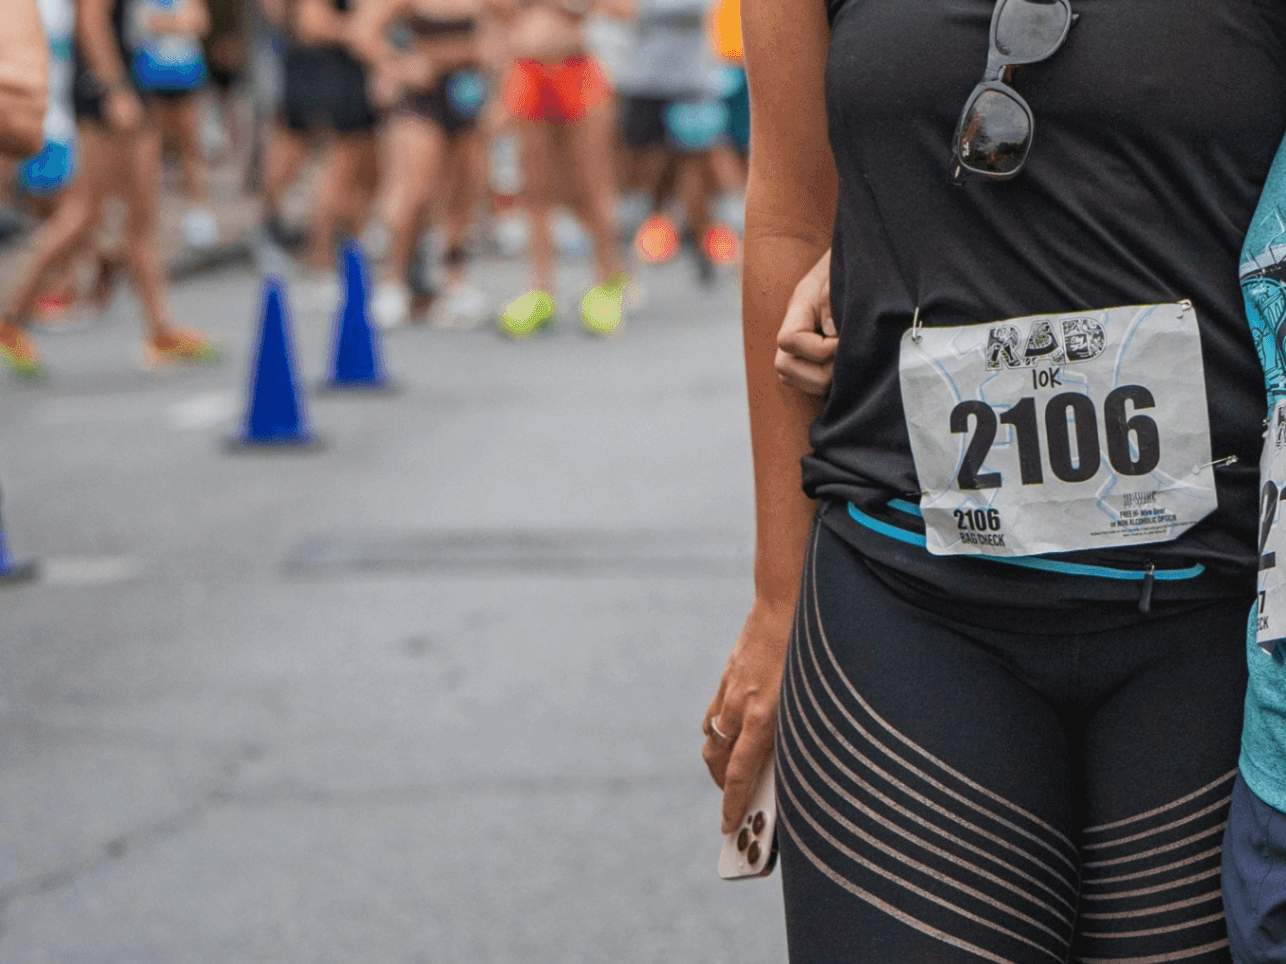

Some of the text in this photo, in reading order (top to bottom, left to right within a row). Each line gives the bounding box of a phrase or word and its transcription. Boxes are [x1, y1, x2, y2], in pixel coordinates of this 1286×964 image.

[1032, 367, 1063, 390] 10K
[949, 384, 1161, 491] 2106
[953, 508, 1001, 532] 2106
[1119, 510, 1132, 518] FREE
